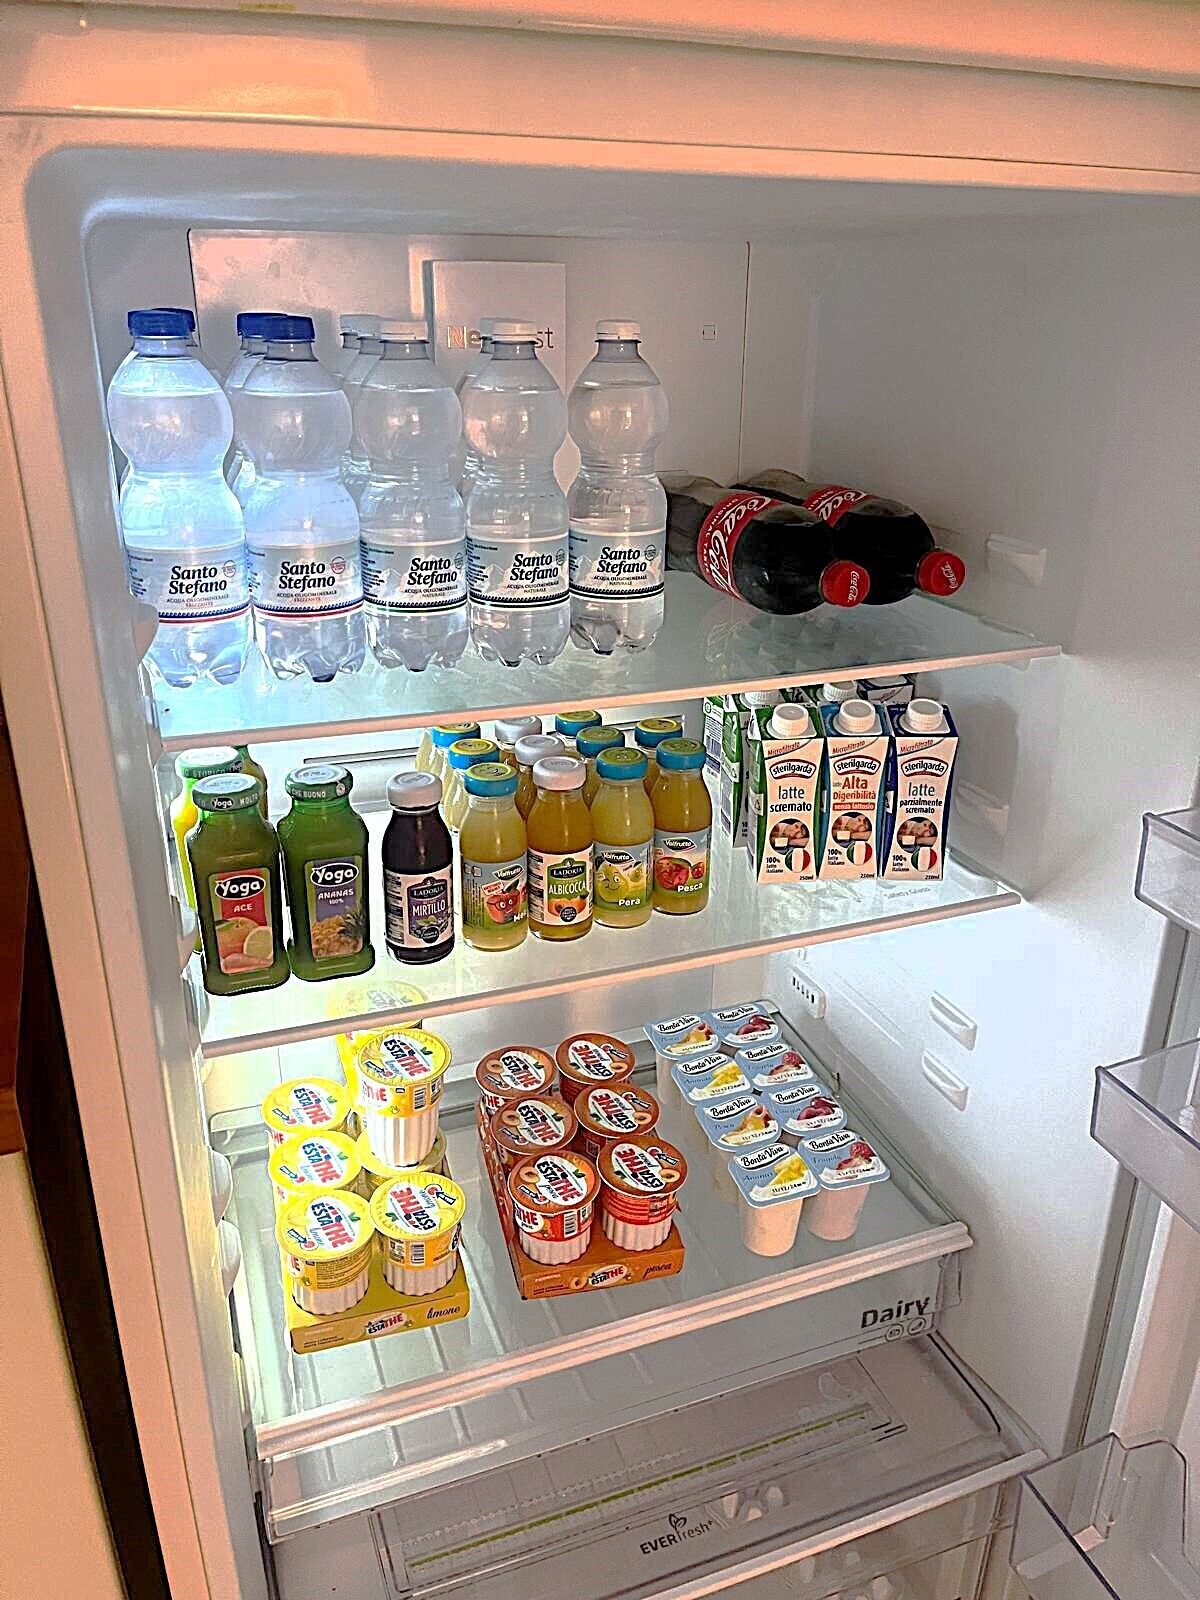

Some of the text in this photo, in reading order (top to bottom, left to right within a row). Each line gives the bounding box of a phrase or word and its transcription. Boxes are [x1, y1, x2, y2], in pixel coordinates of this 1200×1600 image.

[601, 547, 640, 560] Santo
[411, 558, 450, 571] Santo
[513, 554, 552, 567] Santo
[171, 566, 217, 580] Santo
[281, 562, 325, 575] Santo
[597, 561, 647, 577] Stefano
[407, 571, 457, 588] Stefano
[510, 567, 558, 583] Stefano
[169, 580, 227, 597] Stefano
[279, 576, 335, 592] Stefano
[773, 763, 812, 773] sterilgarda
[837, 759, 876, 771] sterilgarda
[905, 761, 944, 772] sterilgarda
[842, 776, 868, 789] Alta
[779, 786, 805, 799] latte
[909, 782, 935, 796] latte
[833, 790, 876, 802] Digeribilità
[213, 799, 232, 808] Yoga
[770, 802, 812, 812] scremato
[900, 798, 943, 808] parzialmente
[316, 868, 354, 883] Yoga
[220, 881, 260, 897] Yoga
[549, 881, 586, 895] ALBICOCCA
[677, 883, 703, 892] Pesca
[318, 889, 354, 900] ANANAS
[233, 904, 253, 912] ACE
[412, 899, 446, 917] MIRTILLO
[618, 898, 641, 906] Pera
[738, 1005, 755, 1015] Viva
[679, 1016, 696, 1027] Viva
[767, 1043, 784, 1054] Viva
[705, 1055, 723, 1067] Viva
[797, 1086, 815, 1097] Viva
[733, 1098, 752, 1110] Viva
[832, 1132, 851, 1144] Viva
[765, 1146, 785, 1158] Viva
[427, 1306, 460, 1319] limone
[861, 1297, 930, 1329] Dairy
